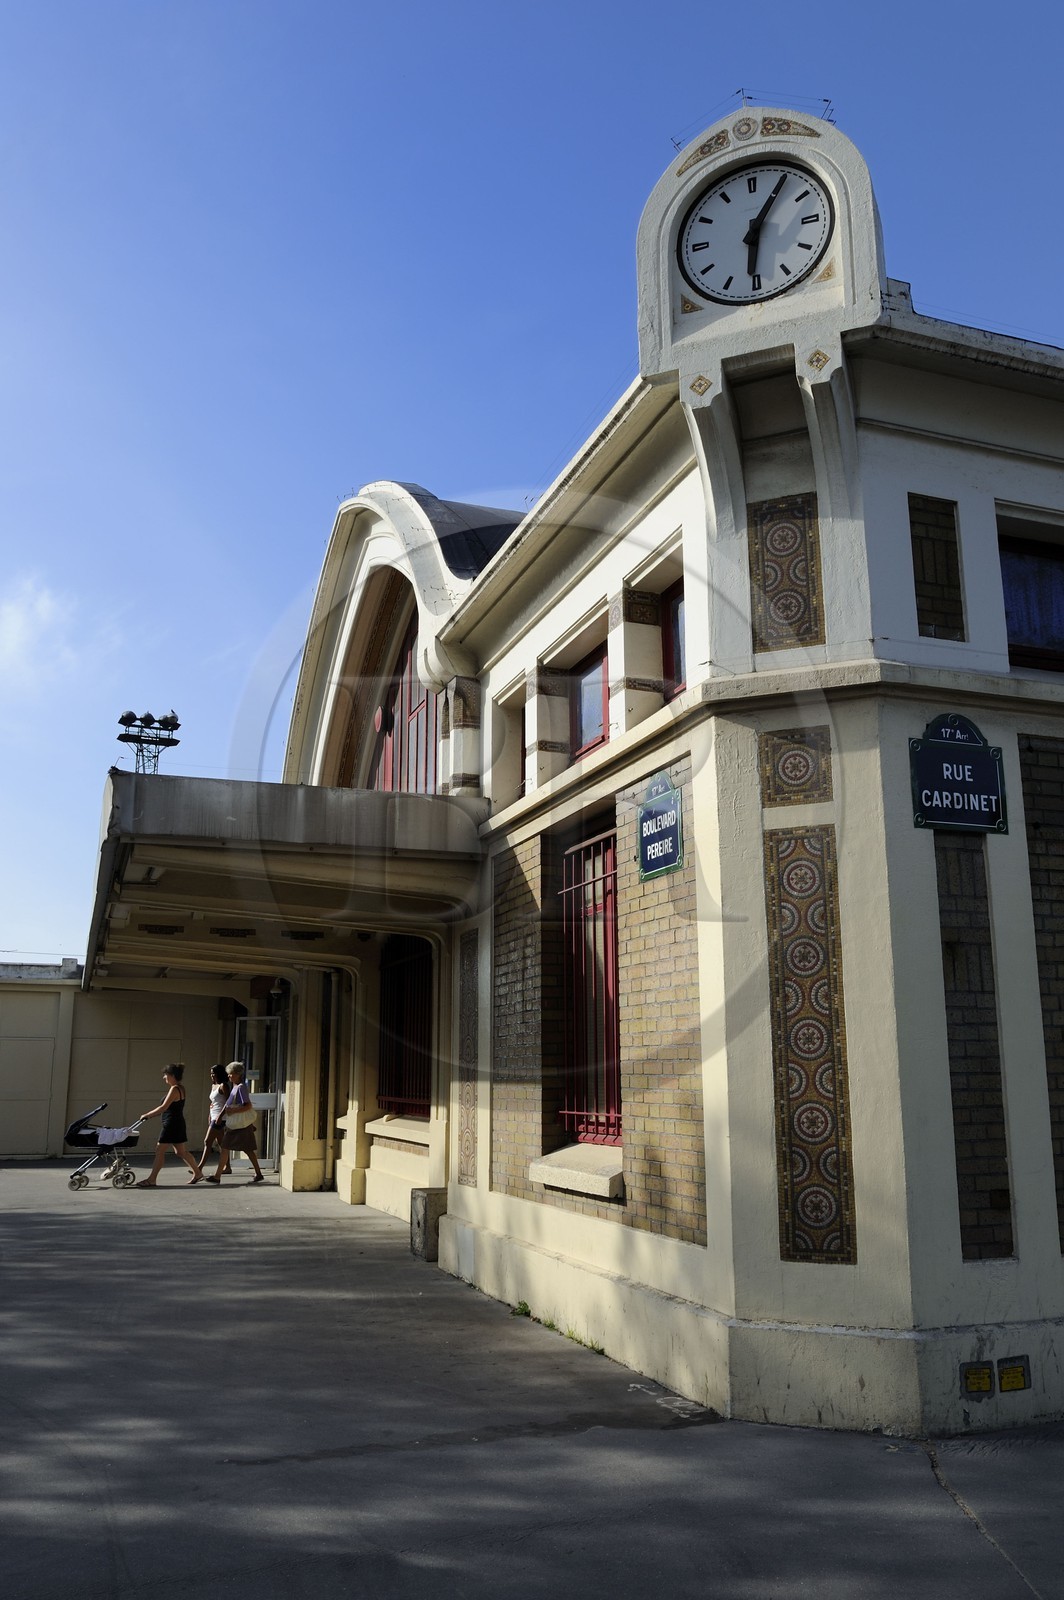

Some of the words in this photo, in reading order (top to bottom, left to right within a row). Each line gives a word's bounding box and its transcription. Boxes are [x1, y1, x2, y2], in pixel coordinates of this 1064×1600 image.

[942, 762, 974, 782] RUE
[922, 789, 998, 812] CARDINET
[642, 810, 677, 837] BOULEVARD
[647, 837, 673, 861] PEREIRE
